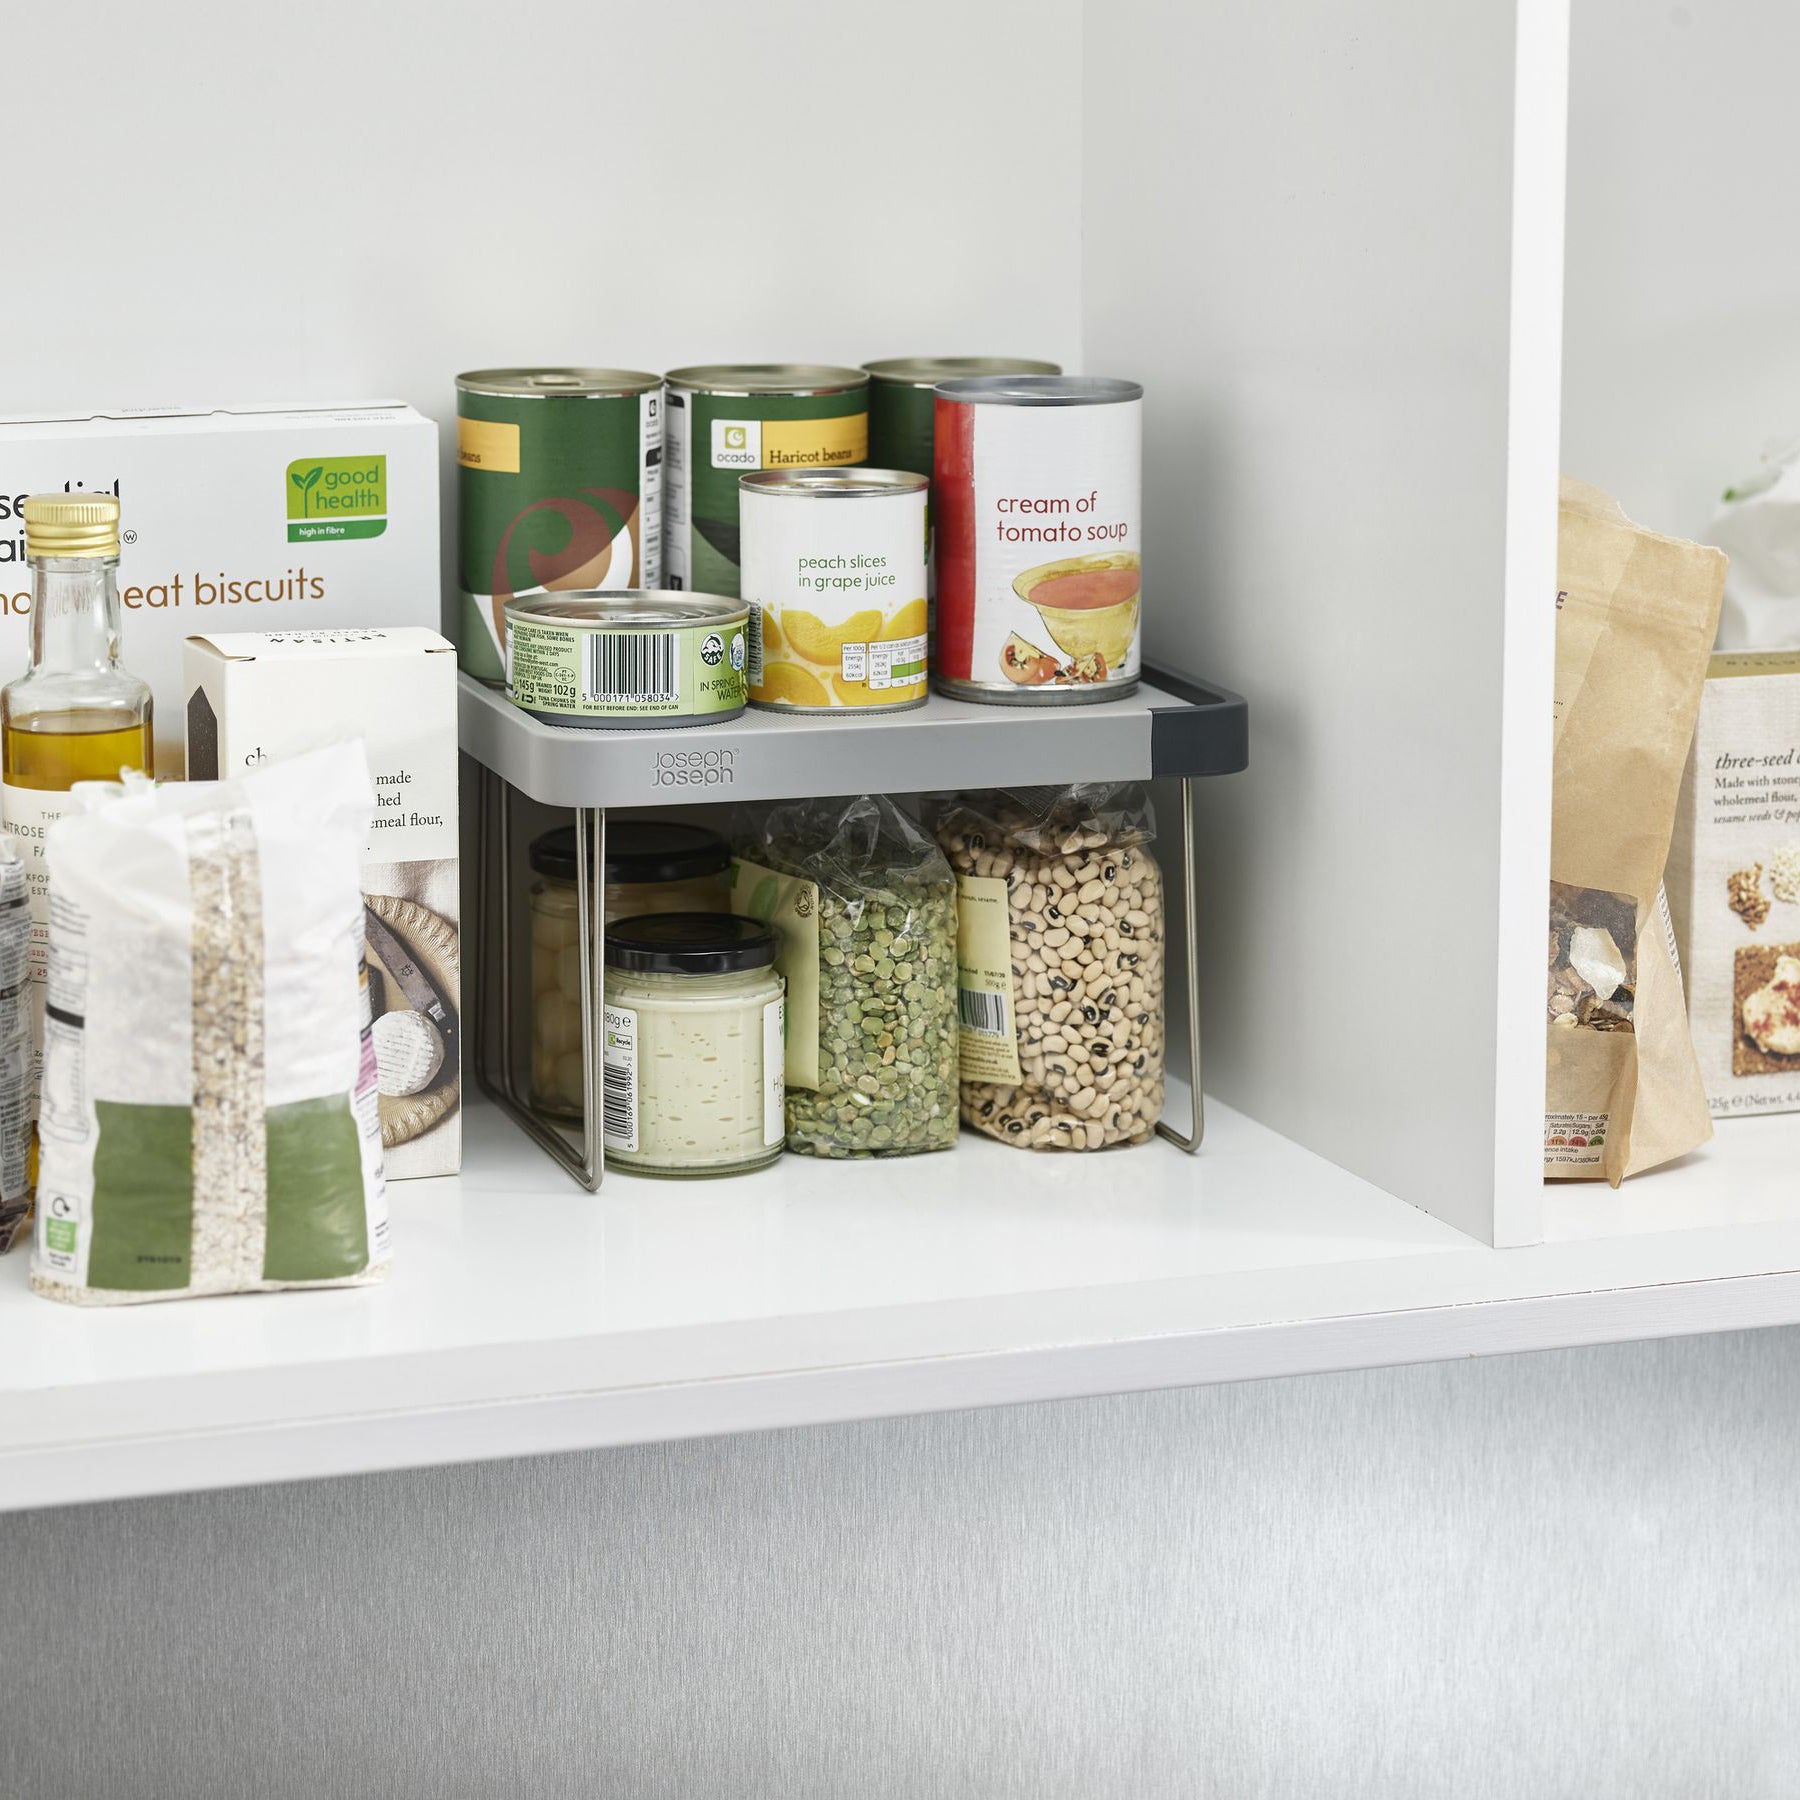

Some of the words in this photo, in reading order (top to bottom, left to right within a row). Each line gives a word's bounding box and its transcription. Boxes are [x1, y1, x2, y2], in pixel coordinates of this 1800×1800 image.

[717, 453, 754, 463] ocado
[770, 450, 819, 464] Haricot
[823, 448, 852, 462] beans
[325, 465, 378, 490] good
[316, 488, 378, 509] health
[997, 498, 1069, 513] cream
[1076, 491, 1097, 512] of
[300, 528, 316, 537] high
[997, 520, 1081, 542] tomato
[1088, 523, 1128, 542] soup
[799, 555, 846, 572] peach
[850, 555, 886, 568] slices
[195, 567, 324, 605] biscuits
[799, 573, 810, 587] in
[815, 577, 861, 592] grape
[865, 573, 895, 591] juice
[705, 654, 722, 665] SAFE
[520, 679, 534, 693] 145g
[701, 681, 709, 691] IN
[712, 677, 735, 690] SPRING
[593, 694, 629, 702] 000171
[635, 694, 671, 702] 058034
[652, 749, 733, 768] Joseph
[1715, 749, 1794, 770] three-seed
[376, 770, 412, 785] made
[652, 767, 733, 786] Joseph
[1715, 778, 1744, 789] Made
[1747, 776, 1769, 787] with
[1714, 793, 1768, 806] wholemeal
[1771, 792, 1798, 803] flour,
[410, 812, 443, 827] flour,
[1714, 813, 1746, 824] sesame
[1749, 810, 1771, 822] seeds
[604, 1011, 620, 1028] 80g
